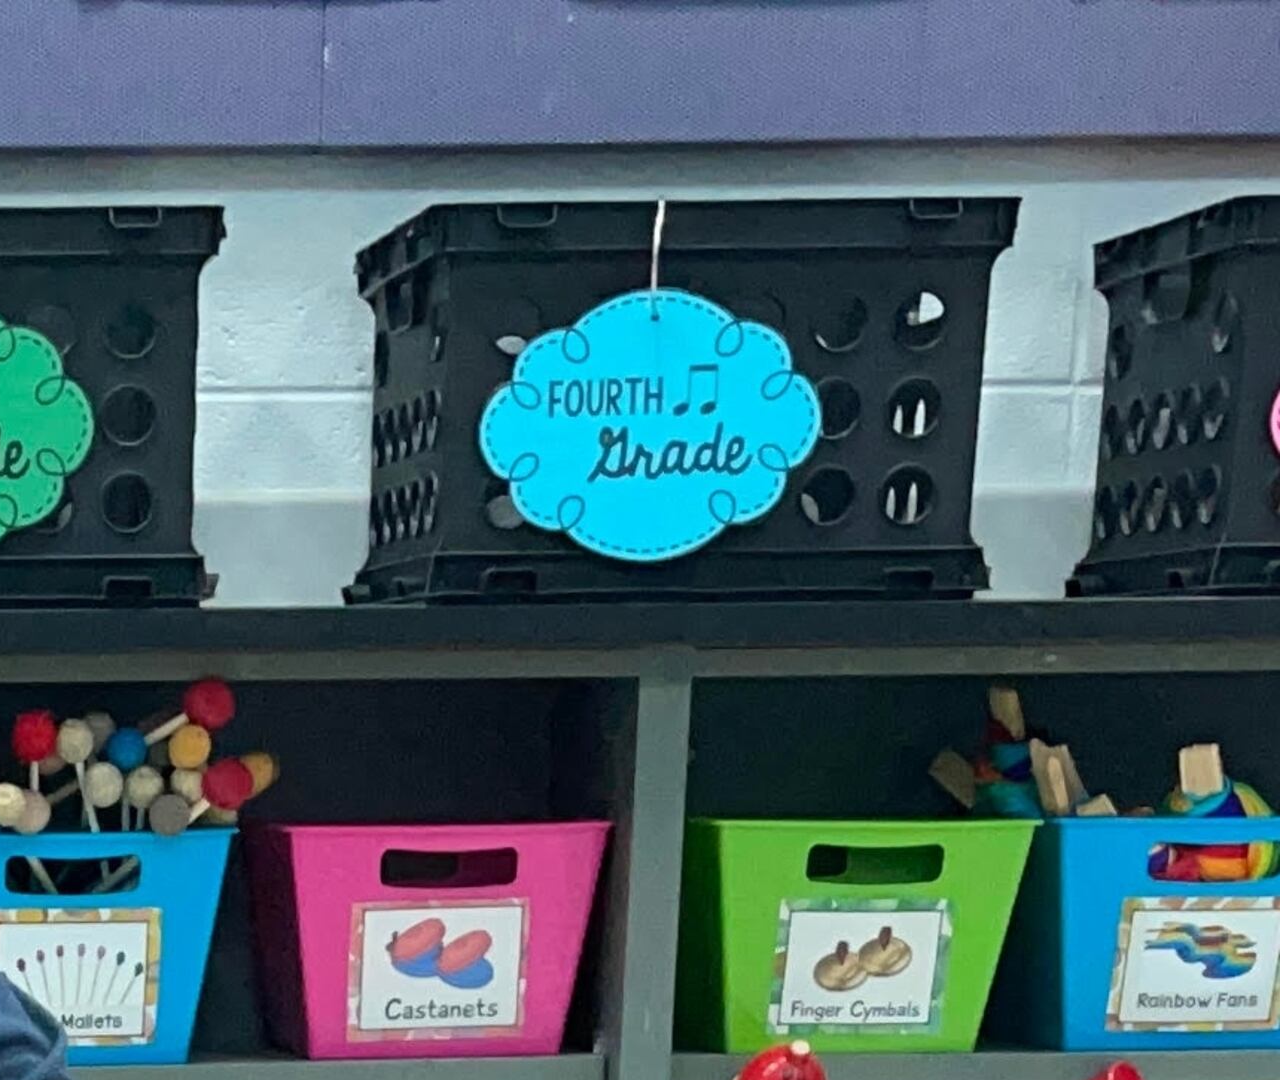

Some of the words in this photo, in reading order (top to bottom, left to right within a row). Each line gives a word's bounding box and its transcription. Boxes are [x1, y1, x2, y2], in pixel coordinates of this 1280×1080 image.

[548, 376, 664, 418] FOURTH
[587, 422, 753, 483] Grade
[384, 997, 499, 1020] Castanets
[790, 1000, 844, 1021] Finger
[849, 1000, 920, 1022] Cymbals
[1136, 992, 1213, 1009] Rainbow
[1216, 992, 1259, 1008] Fans
[61, 1013, 123, 1029] Mallets
